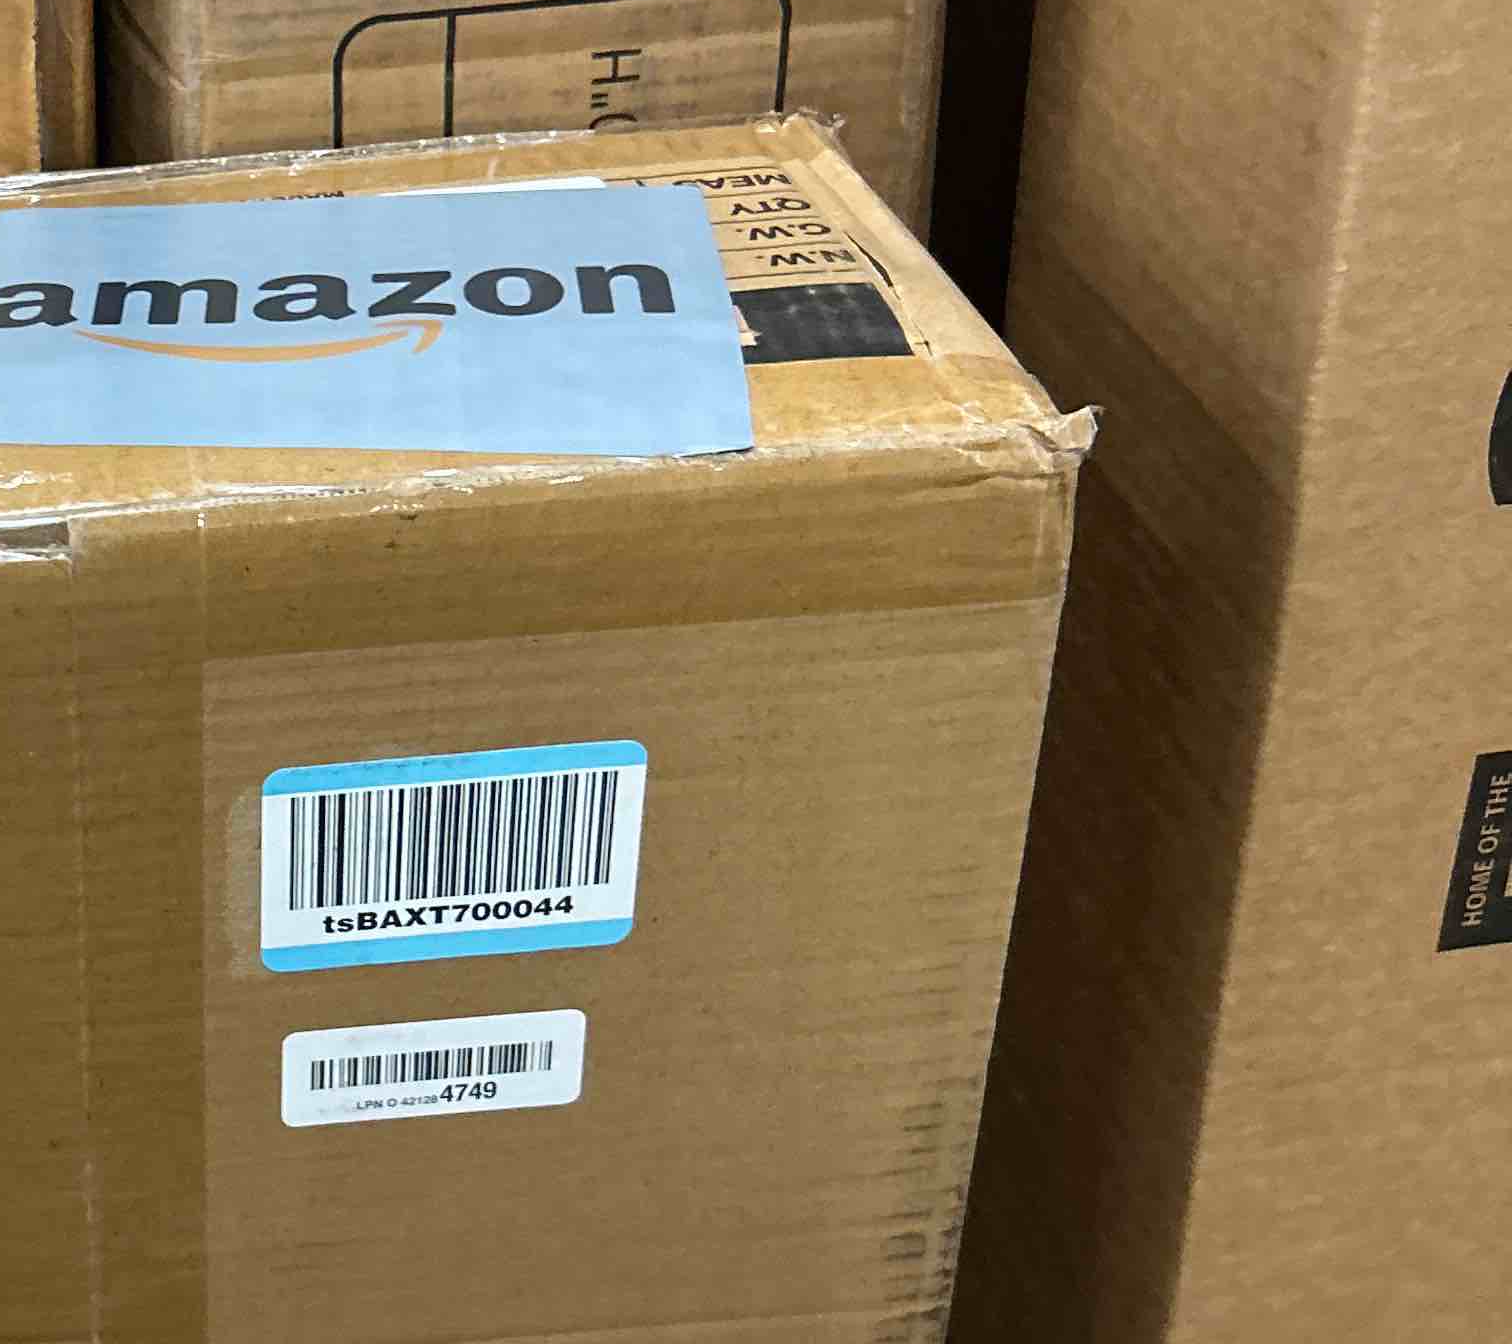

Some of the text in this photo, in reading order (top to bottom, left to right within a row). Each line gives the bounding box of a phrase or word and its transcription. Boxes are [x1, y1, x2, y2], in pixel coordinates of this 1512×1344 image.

[730, 196, 812, 216] QTY
[1460, 772, 1512, 928] HOME OF THE
[322, 895, 574, 934] tsBAXT700044
